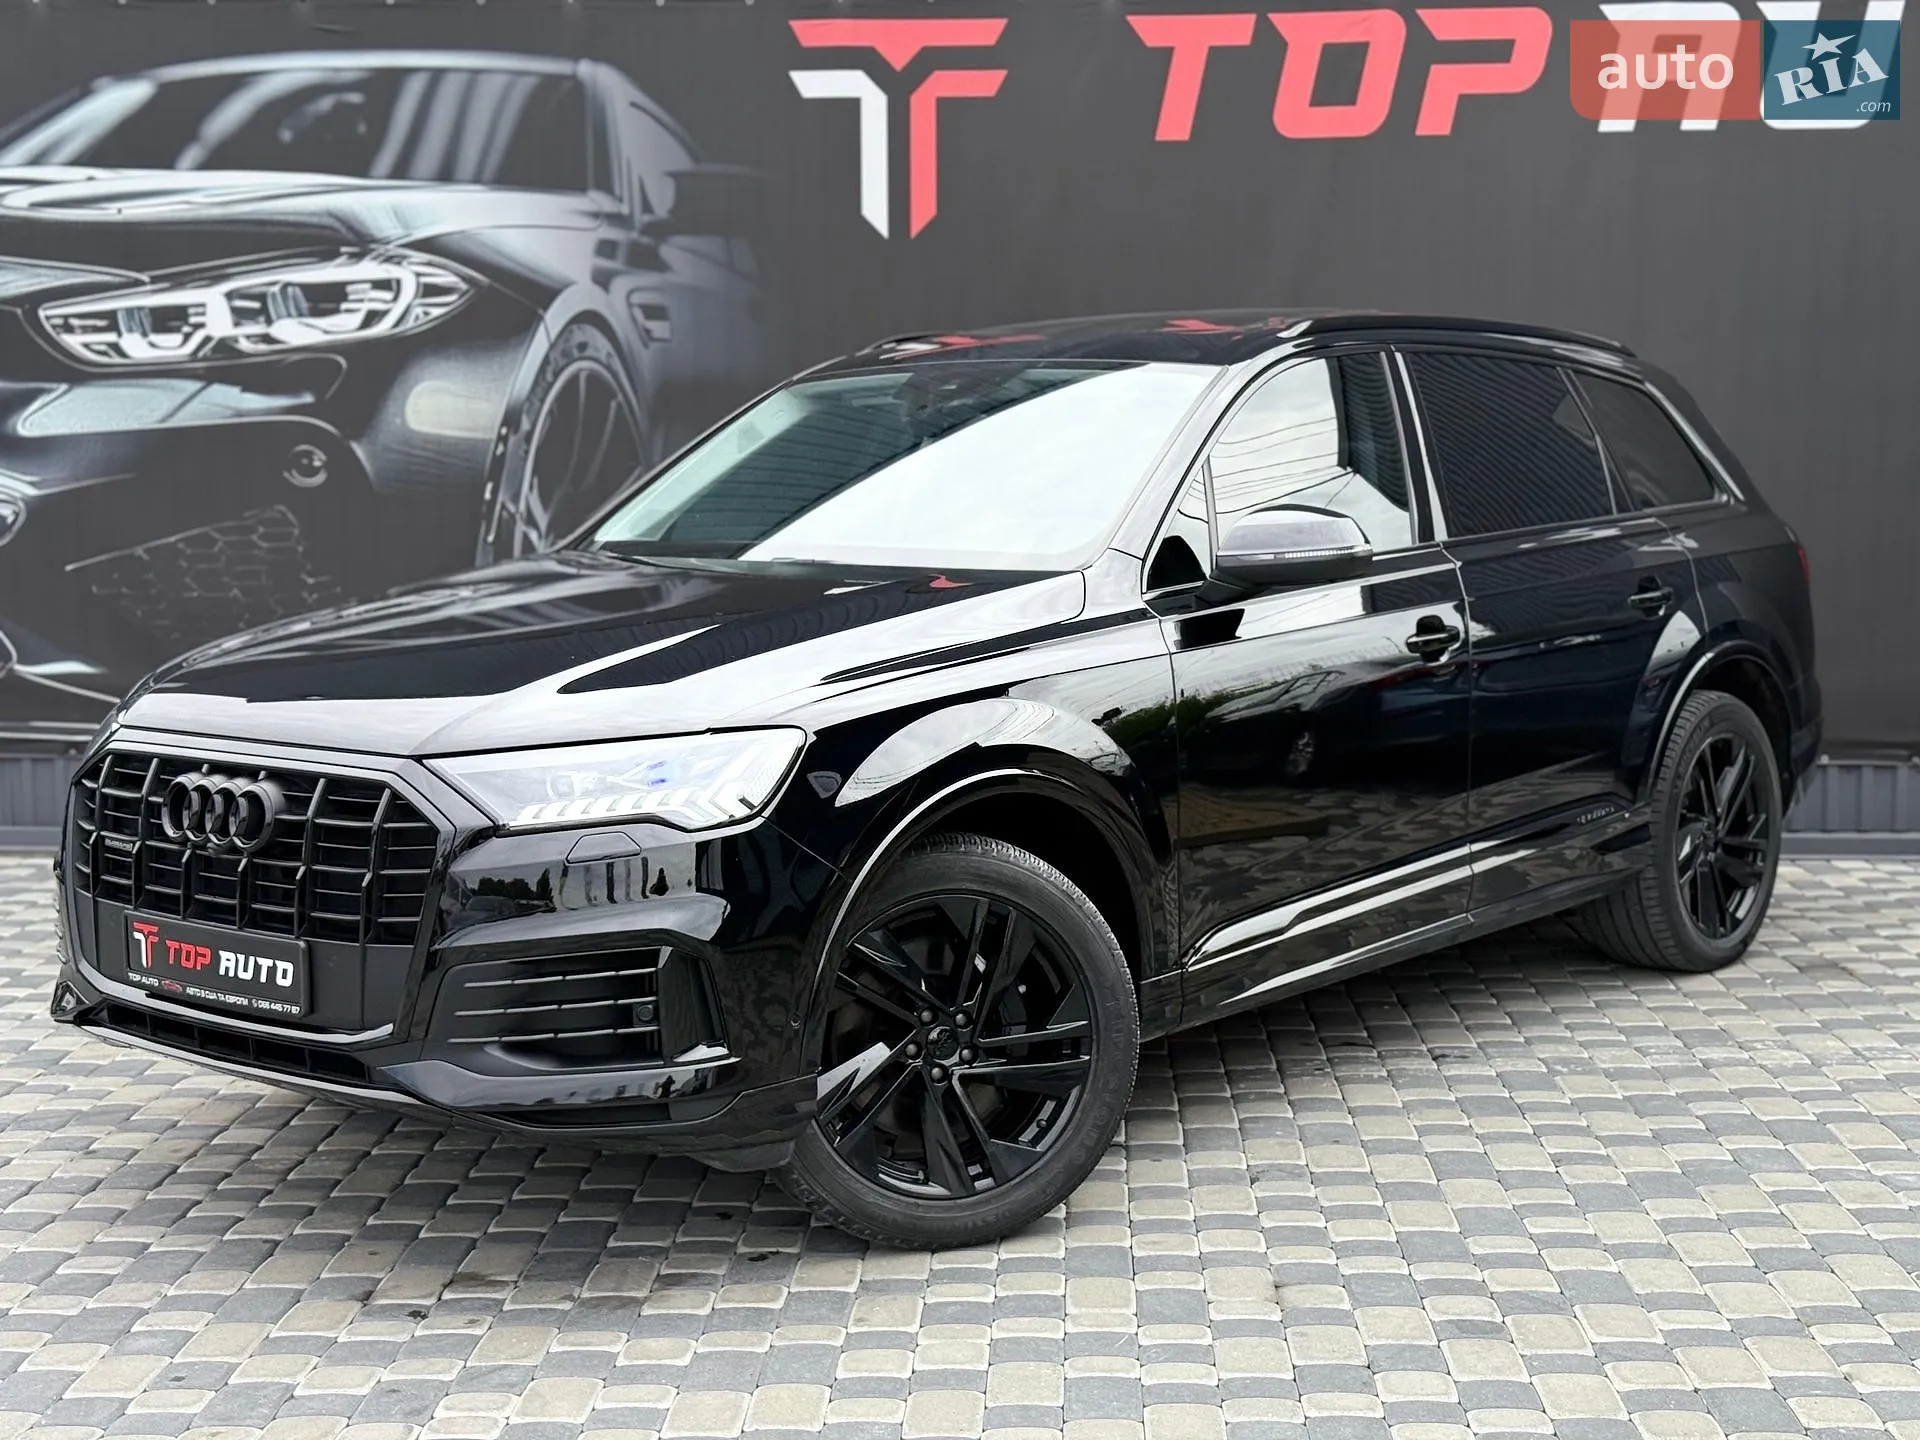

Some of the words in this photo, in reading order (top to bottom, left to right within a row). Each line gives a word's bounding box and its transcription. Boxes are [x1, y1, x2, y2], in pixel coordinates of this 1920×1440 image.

[1126, 6, 1553, 141] TOP
[128, 972, 141, 981] TOP
[141, 976, 159, 987] AUTO
[165, 939, 212, 970] TOP
[218, 949, 294, 988] AUTO
